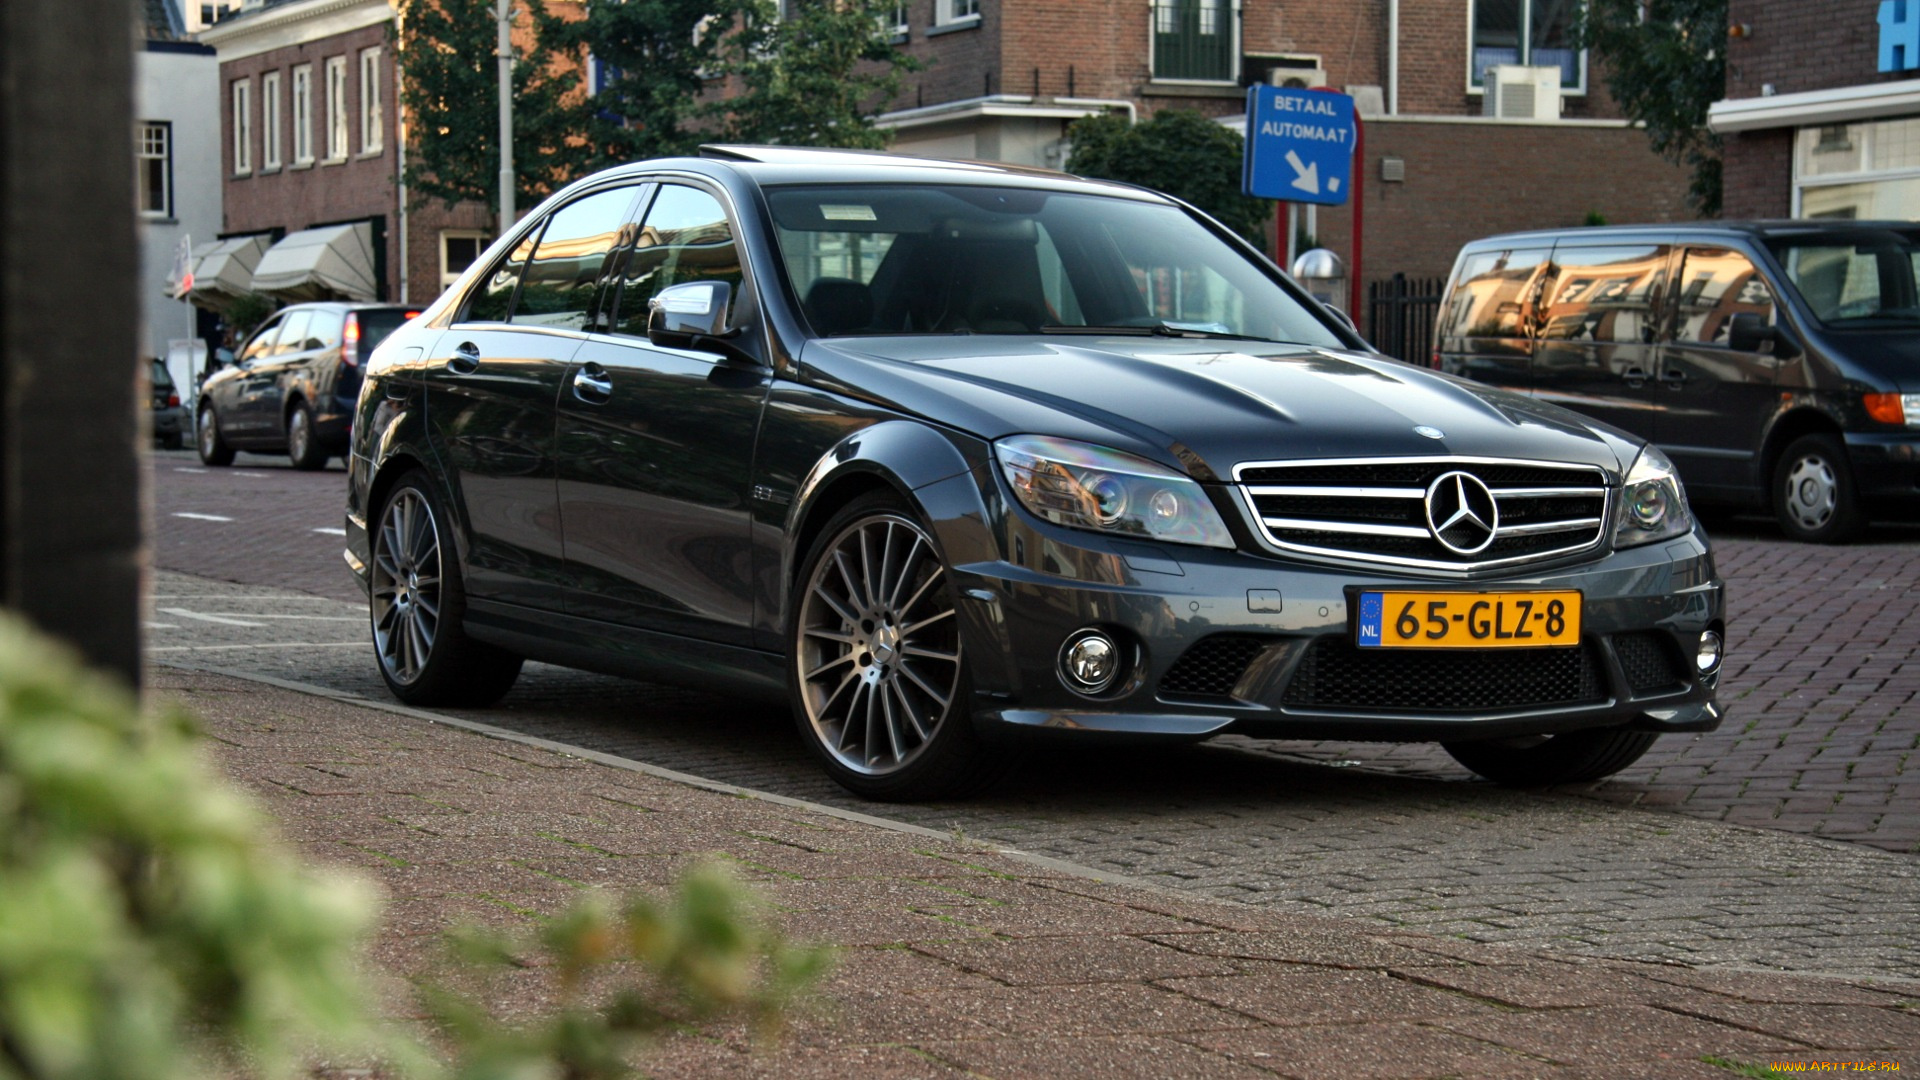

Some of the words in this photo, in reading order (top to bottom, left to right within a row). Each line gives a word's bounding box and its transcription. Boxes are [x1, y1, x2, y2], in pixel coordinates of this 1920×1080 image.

[1274, 95, 1336, 116] BETAAL
[1261, 121, 1347, 143] AUTOMAAT
[1396, 599, 1565, 639] 65-GLZ-8
[1362, 625, 1378, 637] NL
